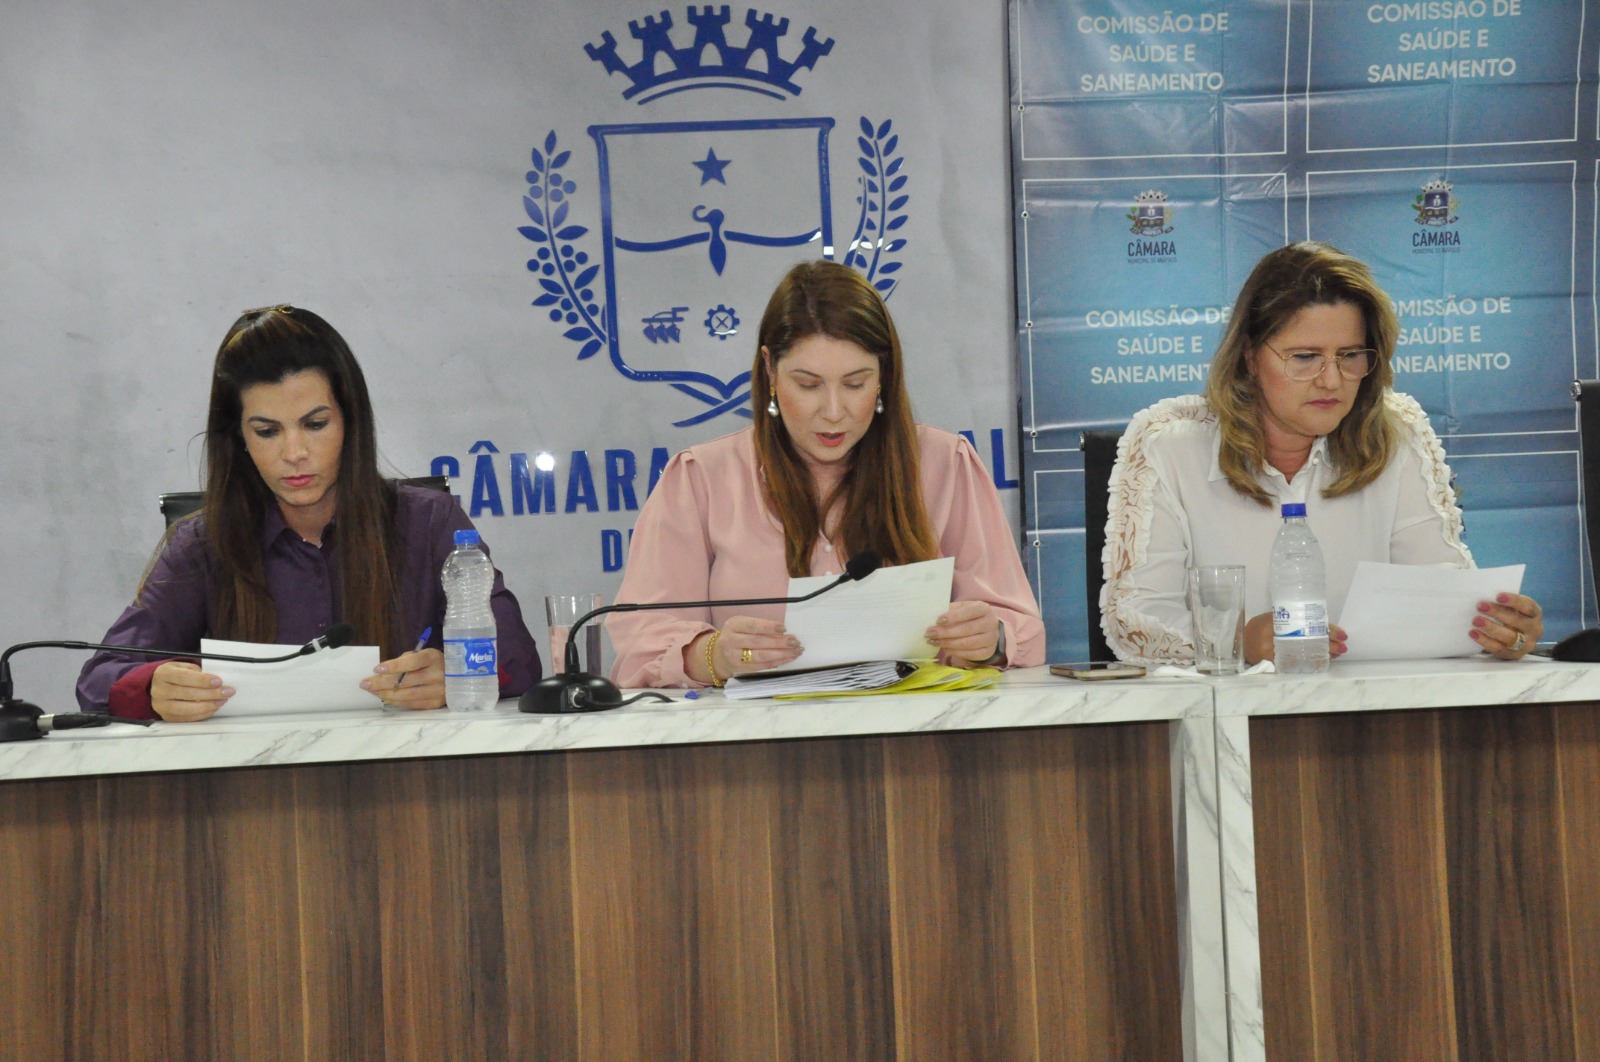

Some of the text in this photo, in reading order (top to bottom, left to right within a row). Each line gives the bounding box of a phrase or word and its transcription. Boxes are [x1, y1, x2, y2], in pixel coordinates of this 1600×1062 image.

[1493, 0, 1522, 17] DE
[1077, 10, 1229, 34] COMISSÃO DE
[1398, 27, 1489, 52] SAÚDE E
[1109, 41, 1196, 63] SAÚDE E
[1080, 72, 1225, 92] SANEAMENTO
[1367, 57, 1517, 84] SANEAMENTO
[1127, 238, 1177, 257] CÂMARA
[1412, 228, 1461, 247] CÂMARA
[1085, 304, 1231, 328] COMISSÃO DE
[1390, 294, 1512, 317] MISSÃO DE
[1117, 333, 1203, 356] SAÚDE E
[1397, 322, 1482, 346] SAÚDE E
[1090, 363, 1210, 385] SANEAMEN
[1389, 352, 1511, 374] NEAMENTO
[601, 528, 634, 573] D
